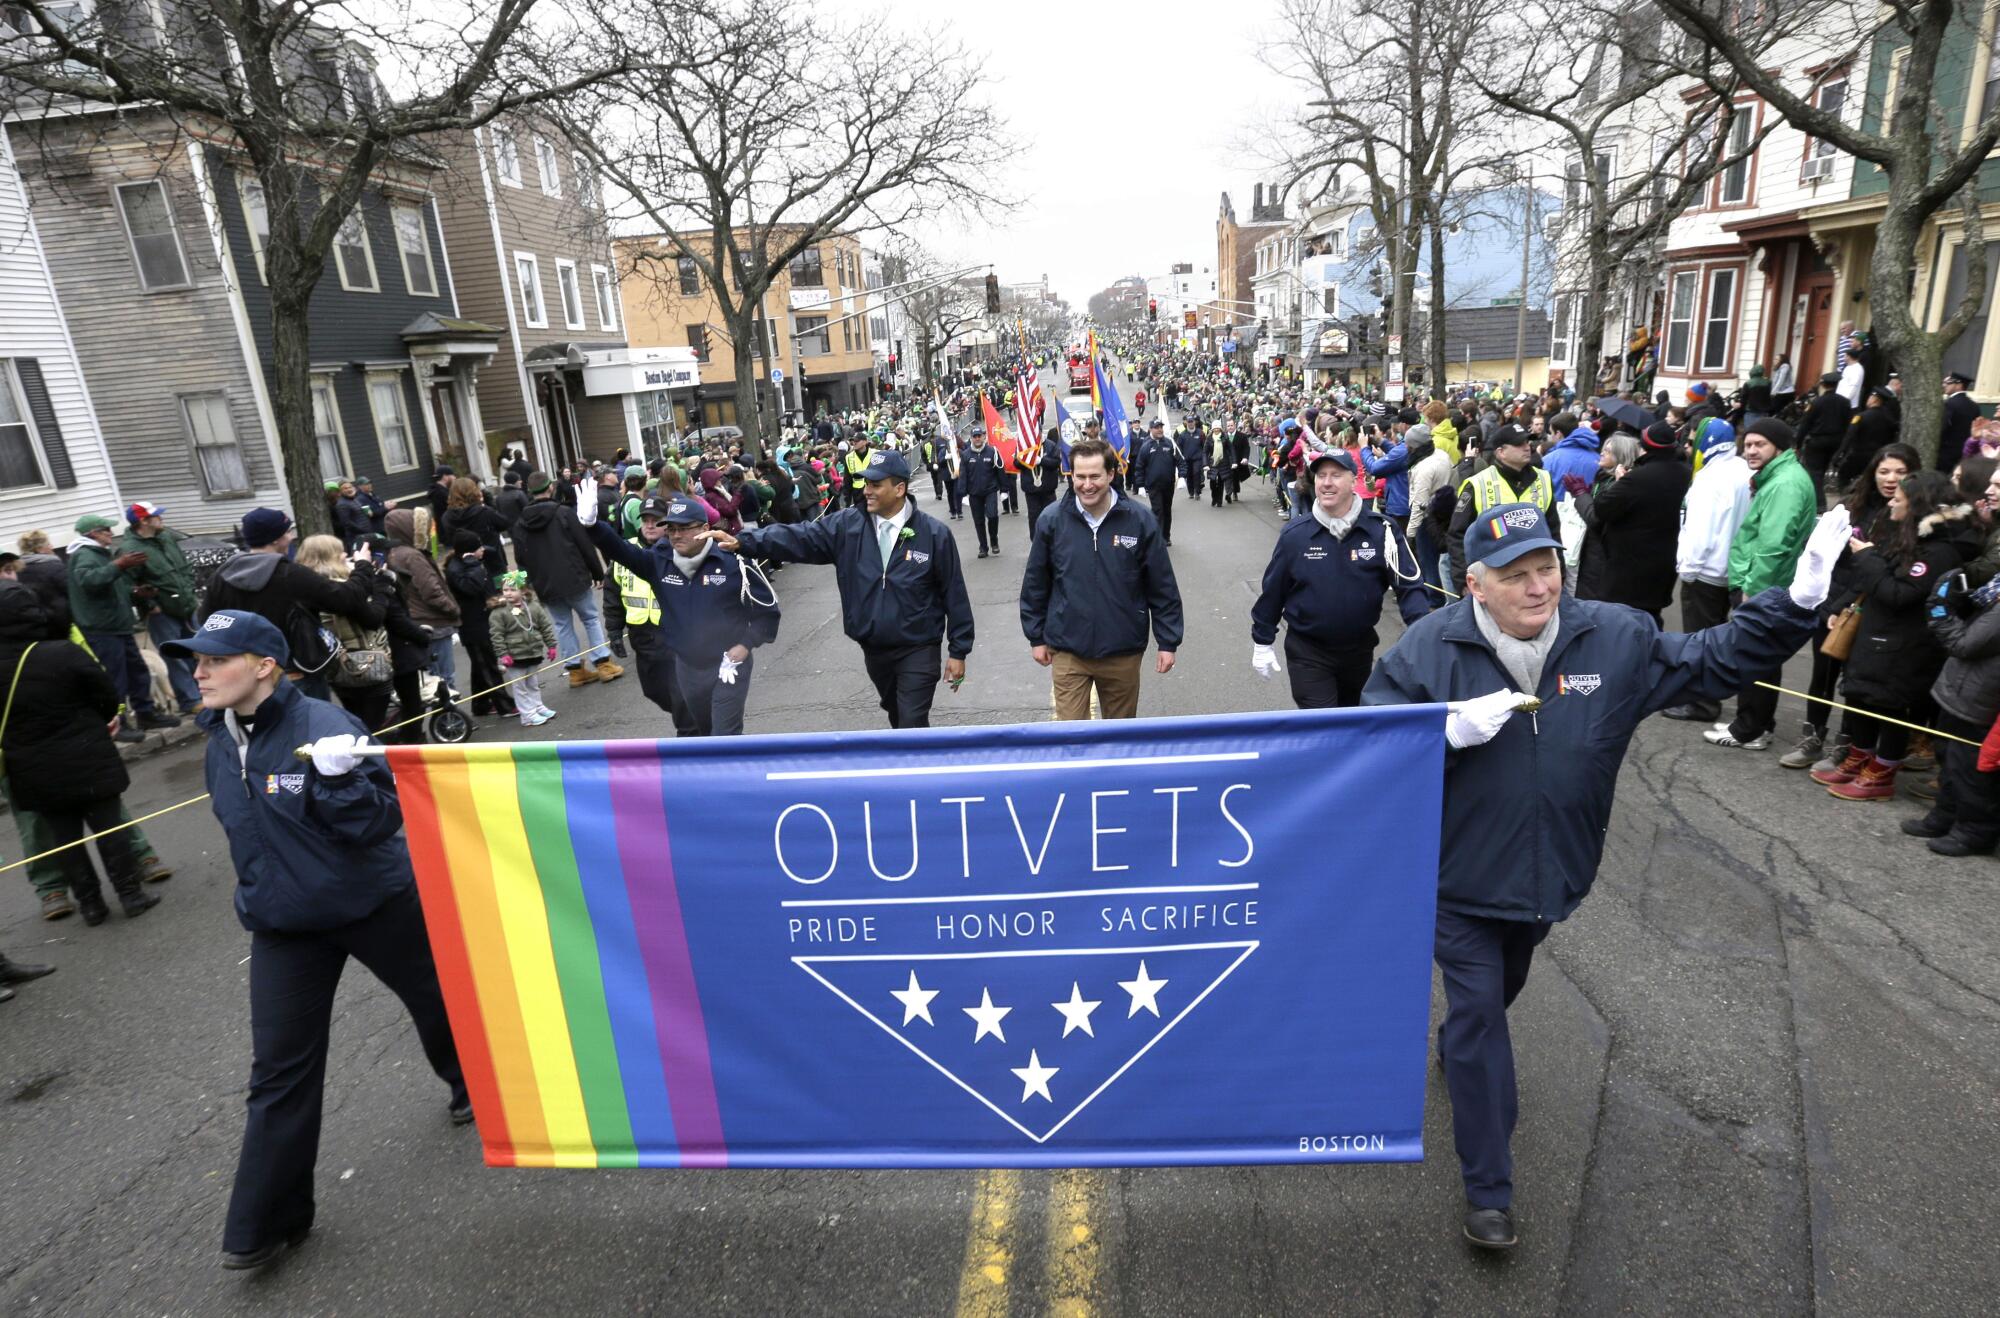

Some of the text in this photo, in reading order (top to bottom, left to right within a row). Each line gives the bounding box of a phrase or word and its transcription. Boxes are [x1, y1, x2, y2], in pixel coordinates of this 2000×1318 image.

[644, 369, 691, 386] Boston Bagel Company
[775, 784, 1254, 884] OUTVETS
[789, 901, 1258, 942] PRIDE HONOR SACRIFICE
[1299, 1135, 1384, 1152] BOSTON
